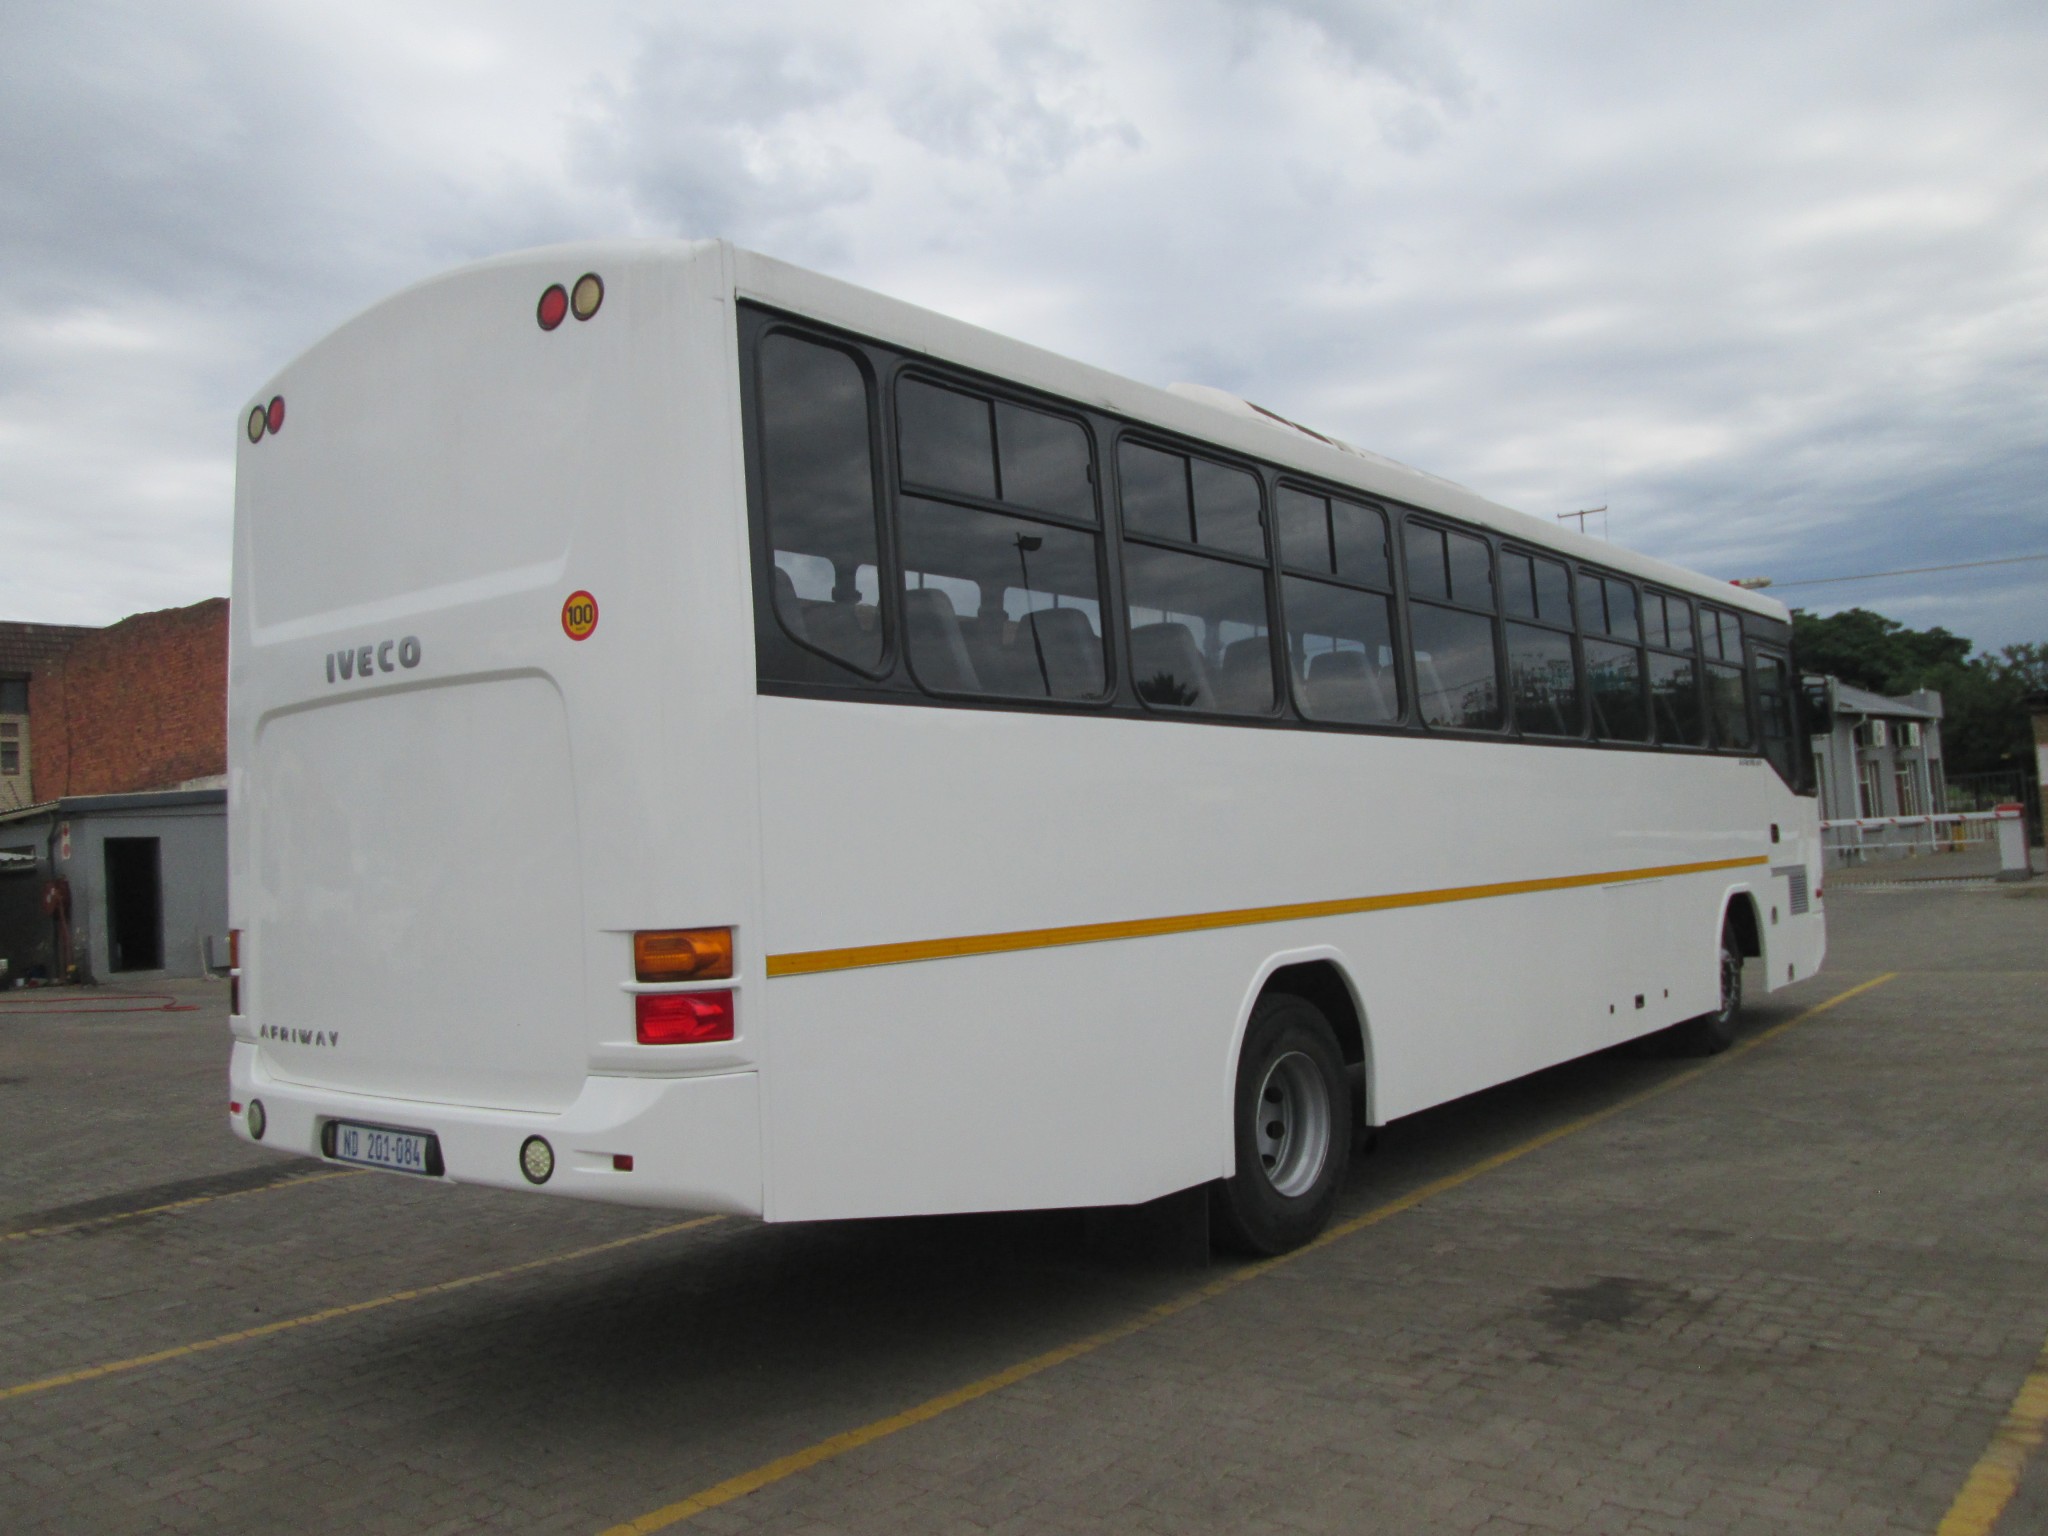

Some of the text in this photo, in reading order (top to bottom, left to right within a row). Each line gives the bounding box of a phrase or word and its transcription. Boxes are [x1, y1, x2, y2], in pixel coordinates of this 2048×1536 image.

[568, 604, 593, 626] 100
[326, 637, 421, 683] IVECO
[261, 1024, 338, 1047] AFRIWAY
[344, 1129, 421, 1166] ND 201-084
